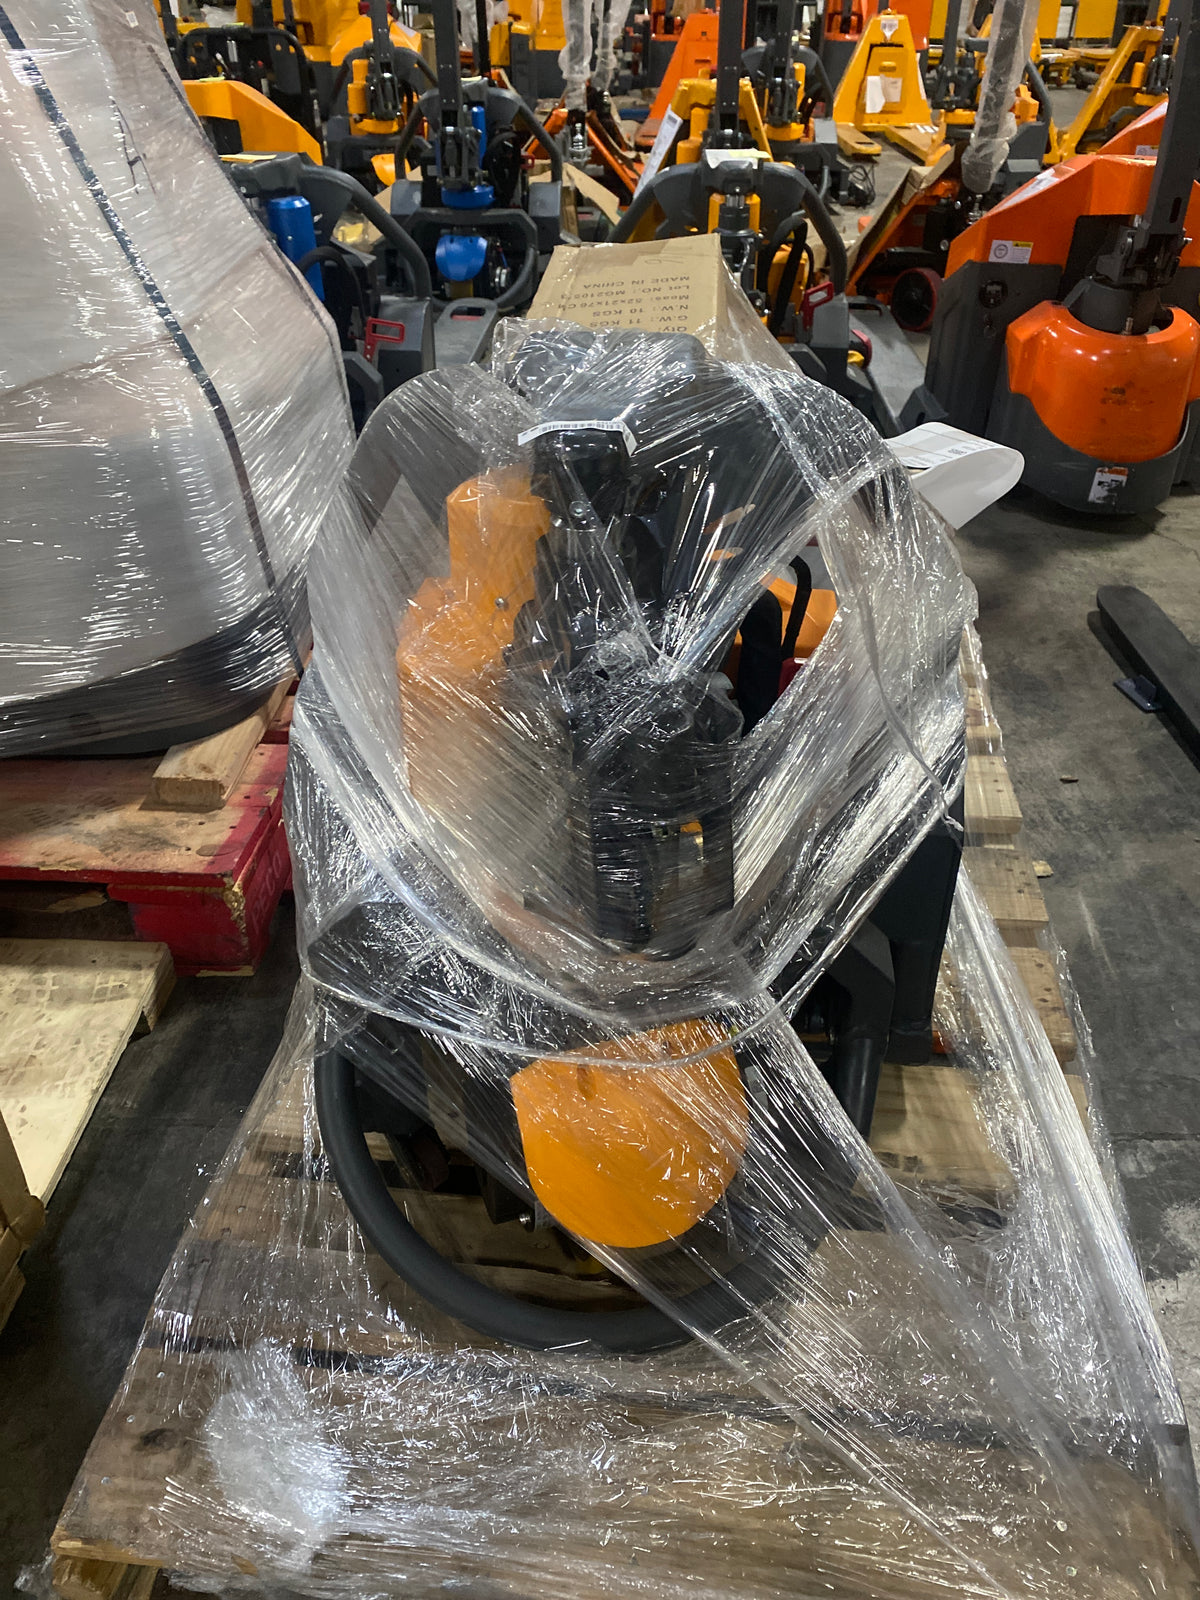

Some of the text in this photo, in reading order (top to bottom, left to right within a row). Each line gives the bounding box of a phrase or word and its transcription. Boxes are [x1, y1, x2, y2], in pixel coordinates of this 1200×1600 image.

[651, 276, 690, 284] MADE
[583, 281, 625, 289] CHINA
[592, 309, 623, 317] KGS
[589, 320, 620, 328] KGS
